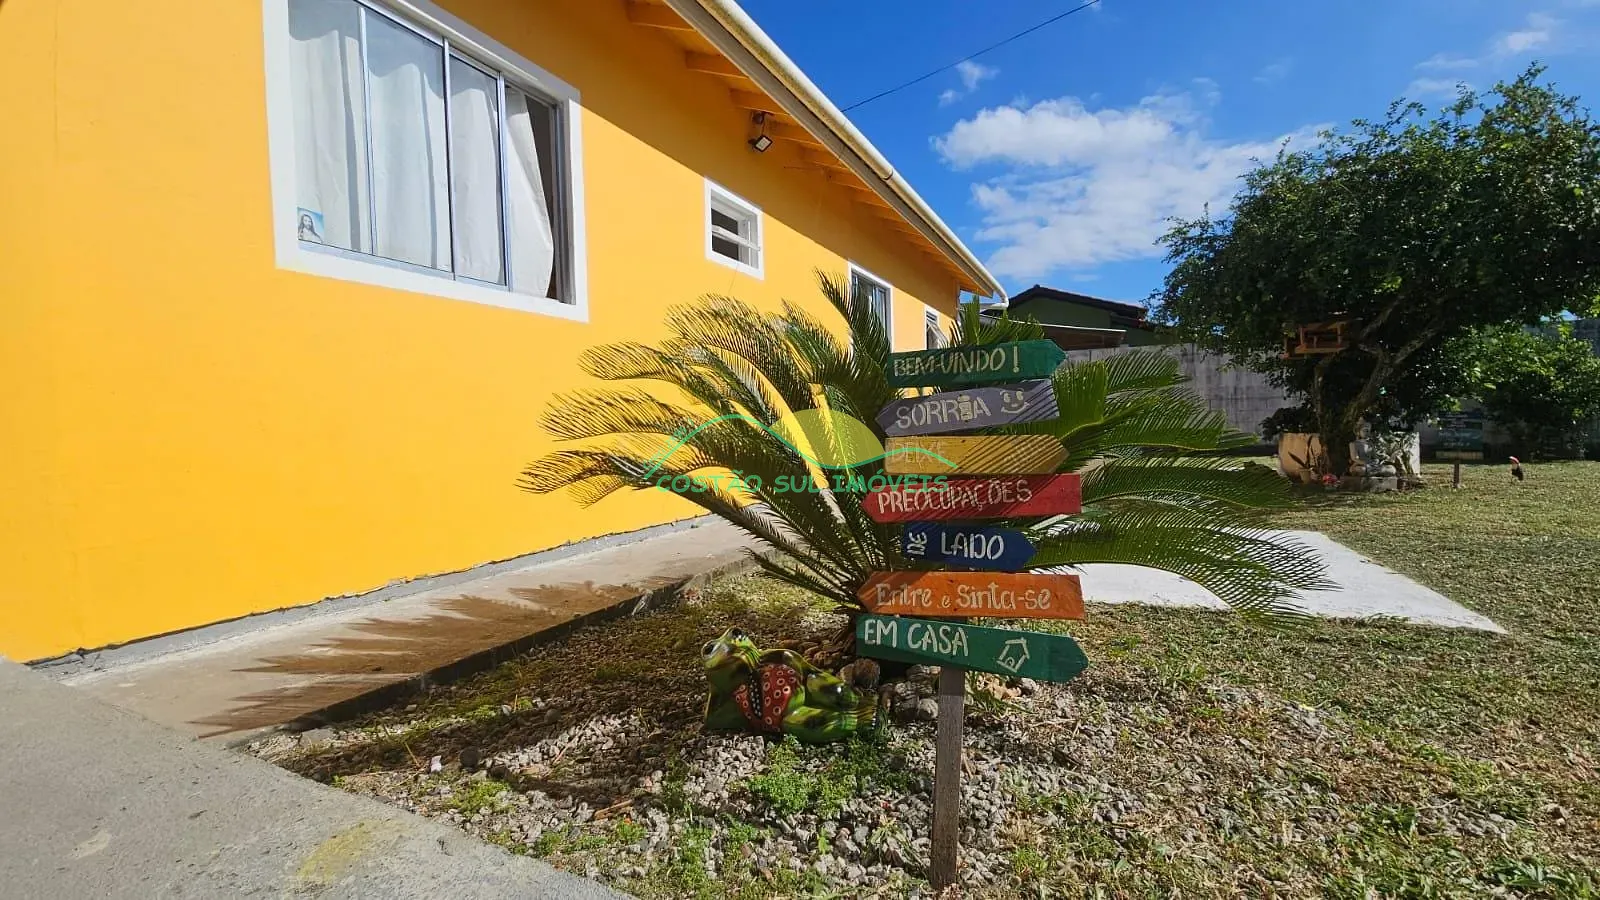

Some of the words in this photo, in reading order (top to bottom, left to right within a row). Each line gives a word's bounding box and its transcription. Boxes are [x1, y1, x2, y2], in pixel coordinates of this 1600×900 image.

[877, 477, 1033, 514] PREOCUPAÇÕES
[906, 531, 928, 556] DE
[940, 531, 1005, 561] LADO
[876, 583, 932, 607] Entre
[956, 581, 1051, 610] Sinta-se
[864, 619, 898, 648] EM
[907, 622, 969, 657] CASA
